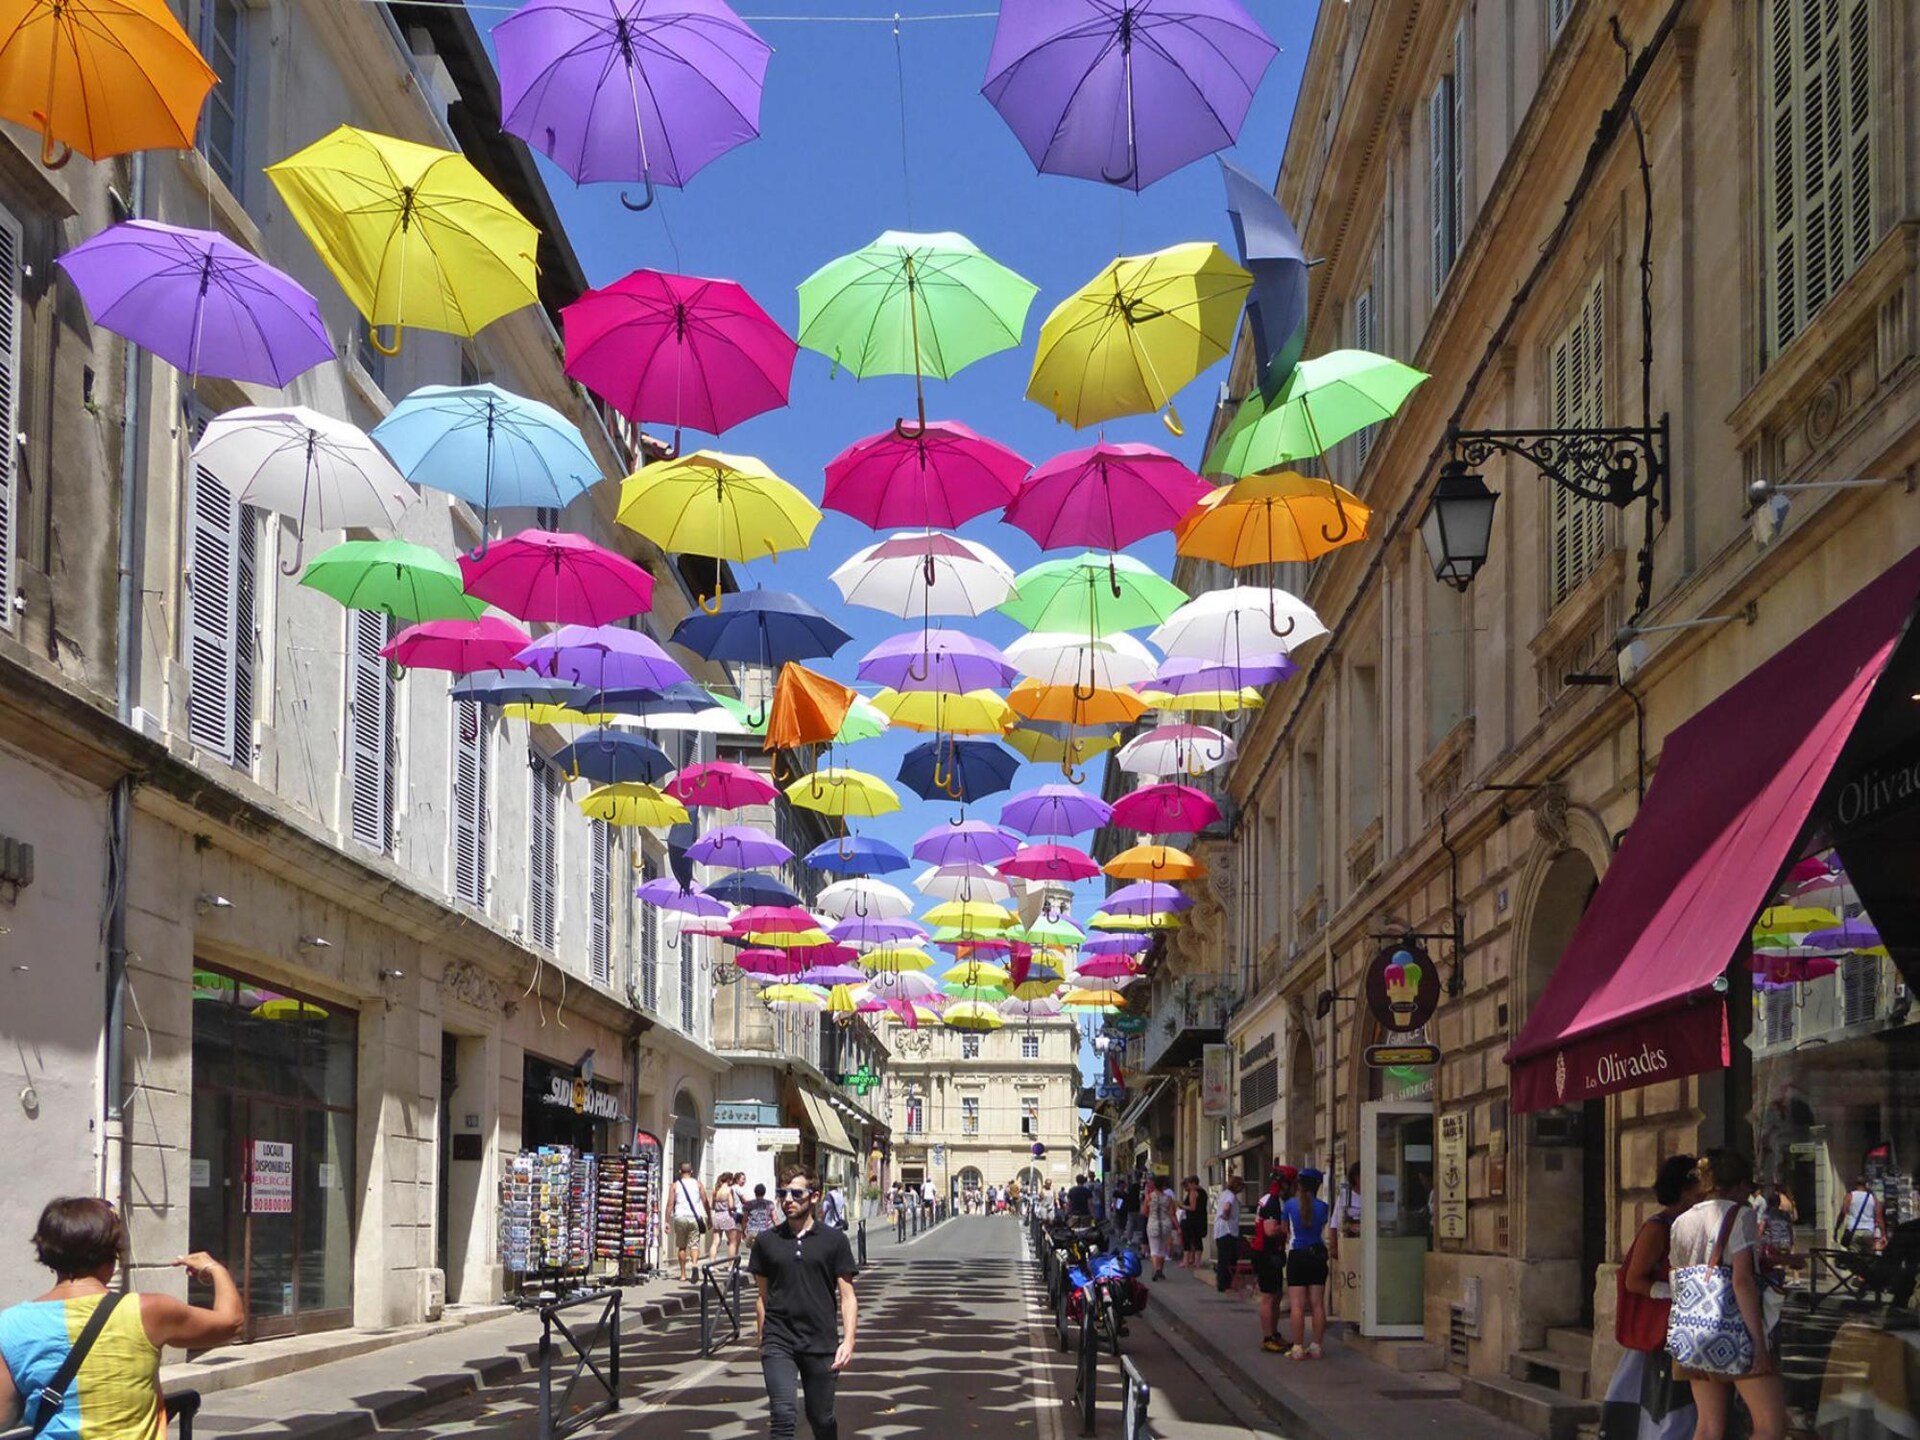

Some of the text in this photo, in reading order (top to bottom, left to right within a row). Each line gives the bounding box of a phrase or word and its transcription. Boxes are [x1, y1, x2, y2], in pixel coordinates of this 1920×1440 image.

[1597, 1043, 1668, 1085] Olivades
[551, 1076, 570, 1106] SUD
[594, 1090, 618, 1120] PHOTO
[263, 1144, 284, 1157] LOCAUX
[255, 1160, 291, 1173] DISPONIBLES
